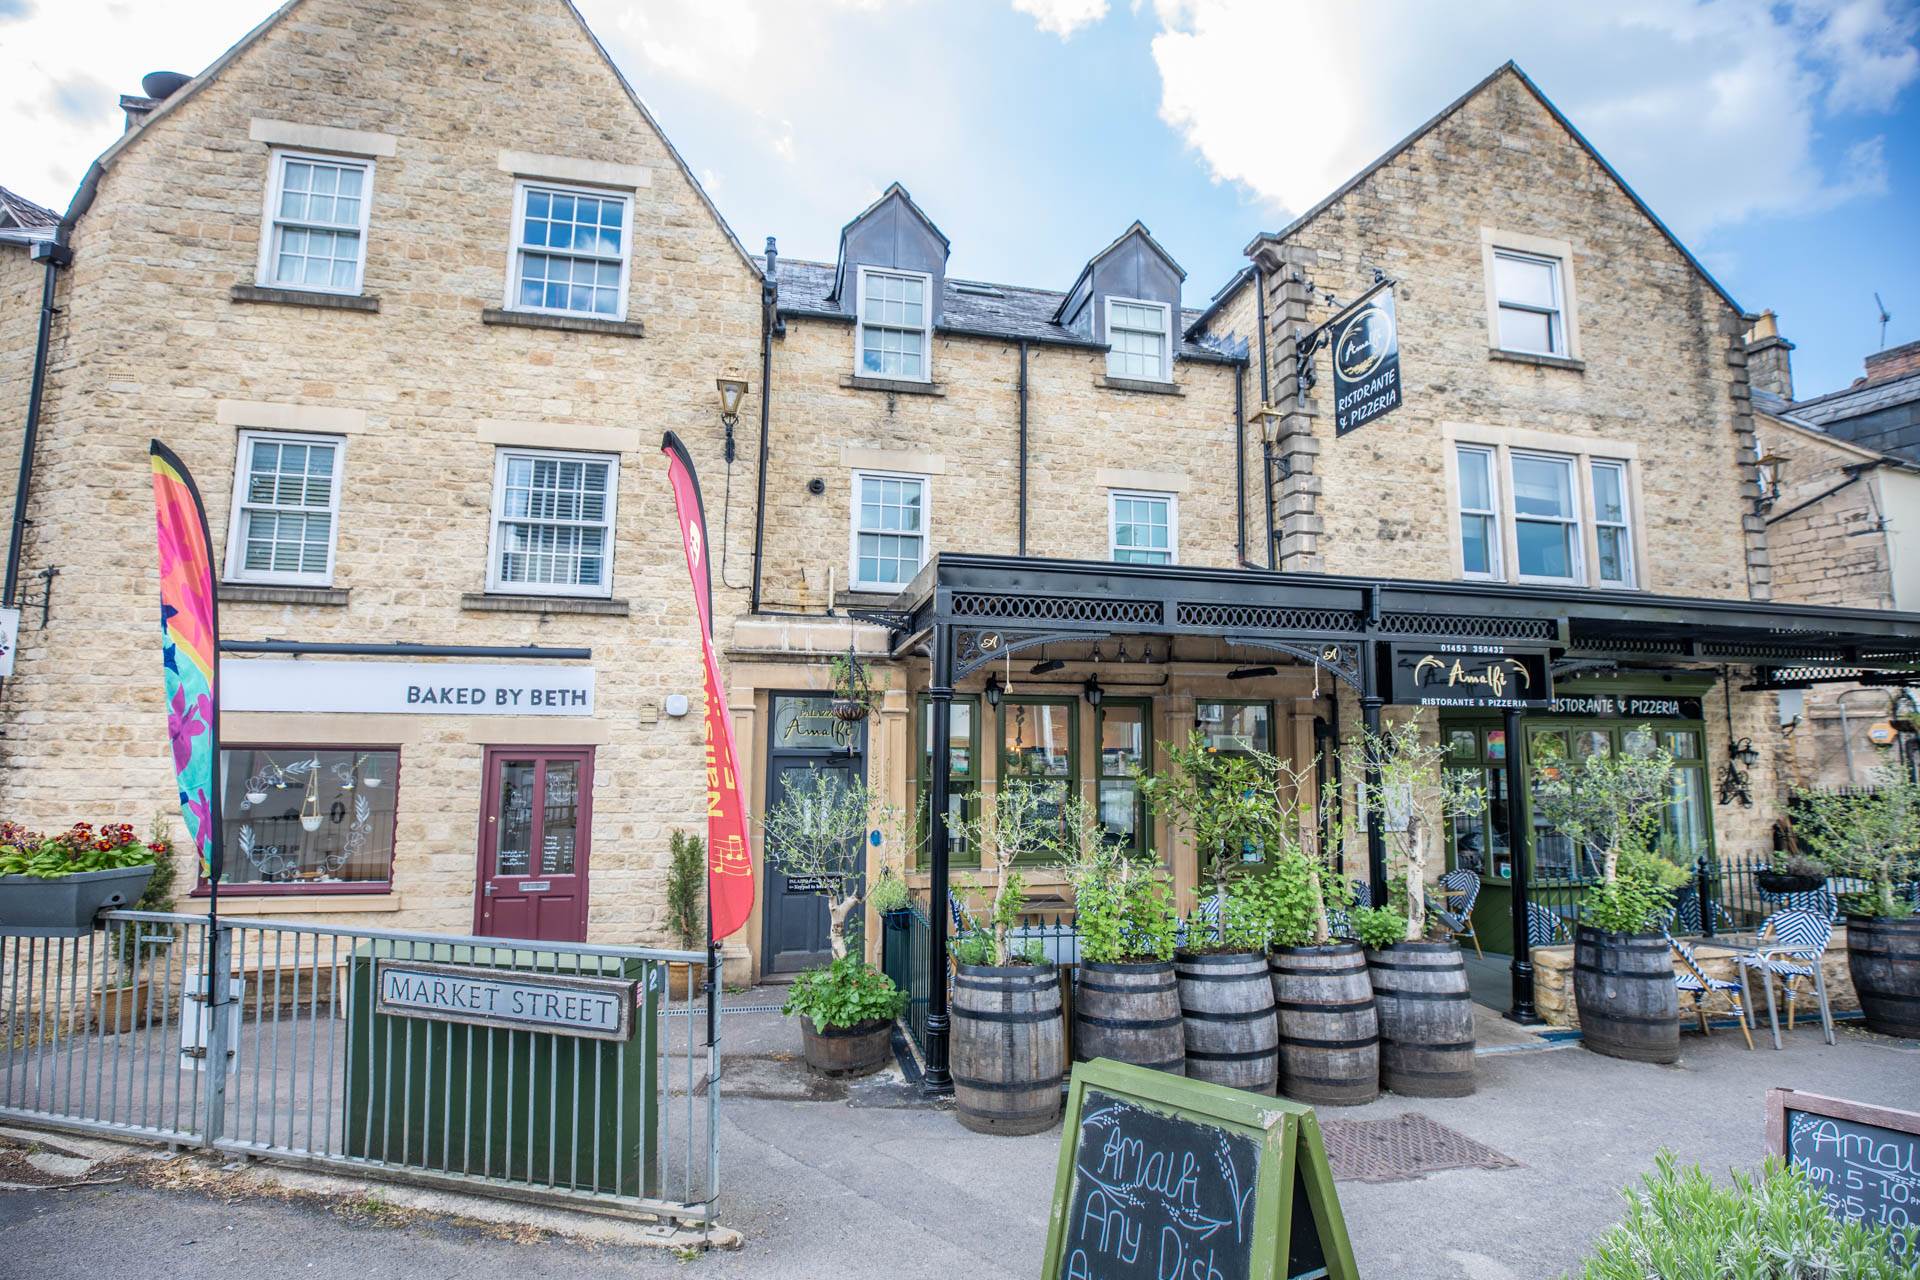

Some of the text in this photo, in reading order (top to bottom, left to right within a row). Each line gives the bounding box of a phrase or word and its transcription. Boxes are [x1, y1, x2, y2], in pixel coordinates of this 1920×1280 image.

[1338, 368, 1396, 412] RISTORANTE
[1340, 388, 1397, 430] & PIZZERIA
[1441, 644, 1467, 652] 01453
[407, 685, 587, 706] BAKED BY BETH
[1448, 658, 1507, 697] Amalfi
[1421, 697, 1475, 706] RISTORANTE
[1488, 699, 1528, 708] PIZZERIA
[1617, 700, 1627, 712] &
[1631, 700, 1680, 714] PIZZERIA
[390, 977, 500, 1010] MARKET
[512, 990, 612, 1024] STREET
[1812, 1121, 1920, 1176] Amal
[1081, 1190, 1142, 1264] Any
